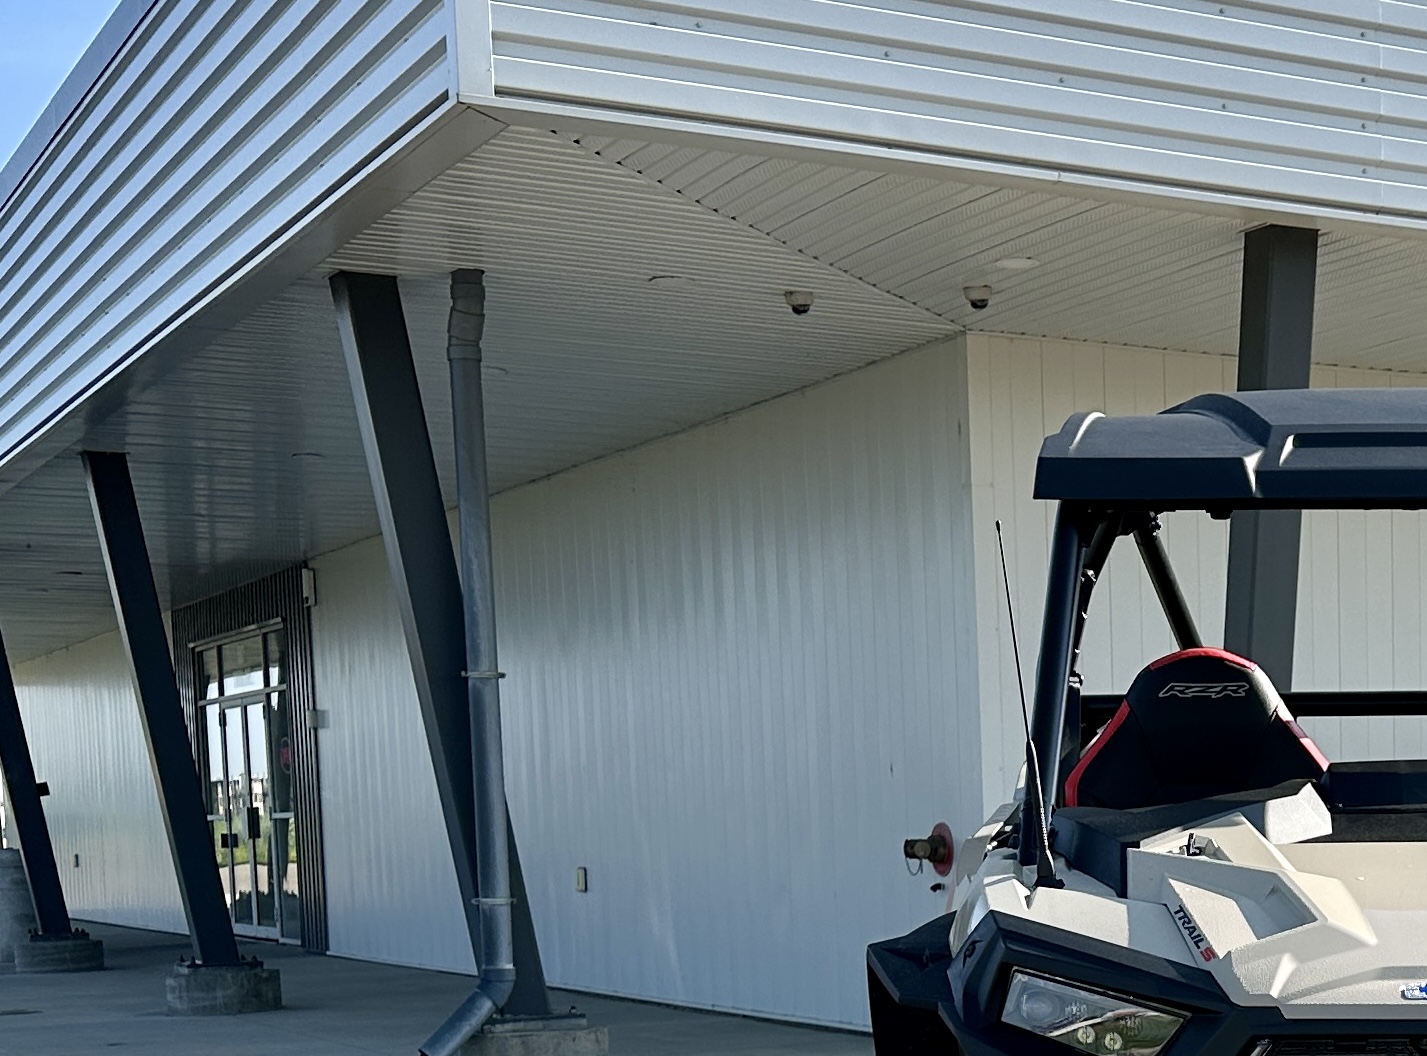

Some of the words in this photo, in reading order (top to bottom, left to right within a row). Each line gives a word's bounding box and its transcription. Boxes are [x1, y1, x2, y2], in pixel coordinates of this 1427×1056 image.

[1159, 682, 1249, 698] RZR
[1174, 904, 1204, 949] TRAIL
[1200, 946, 1218, 962] S
